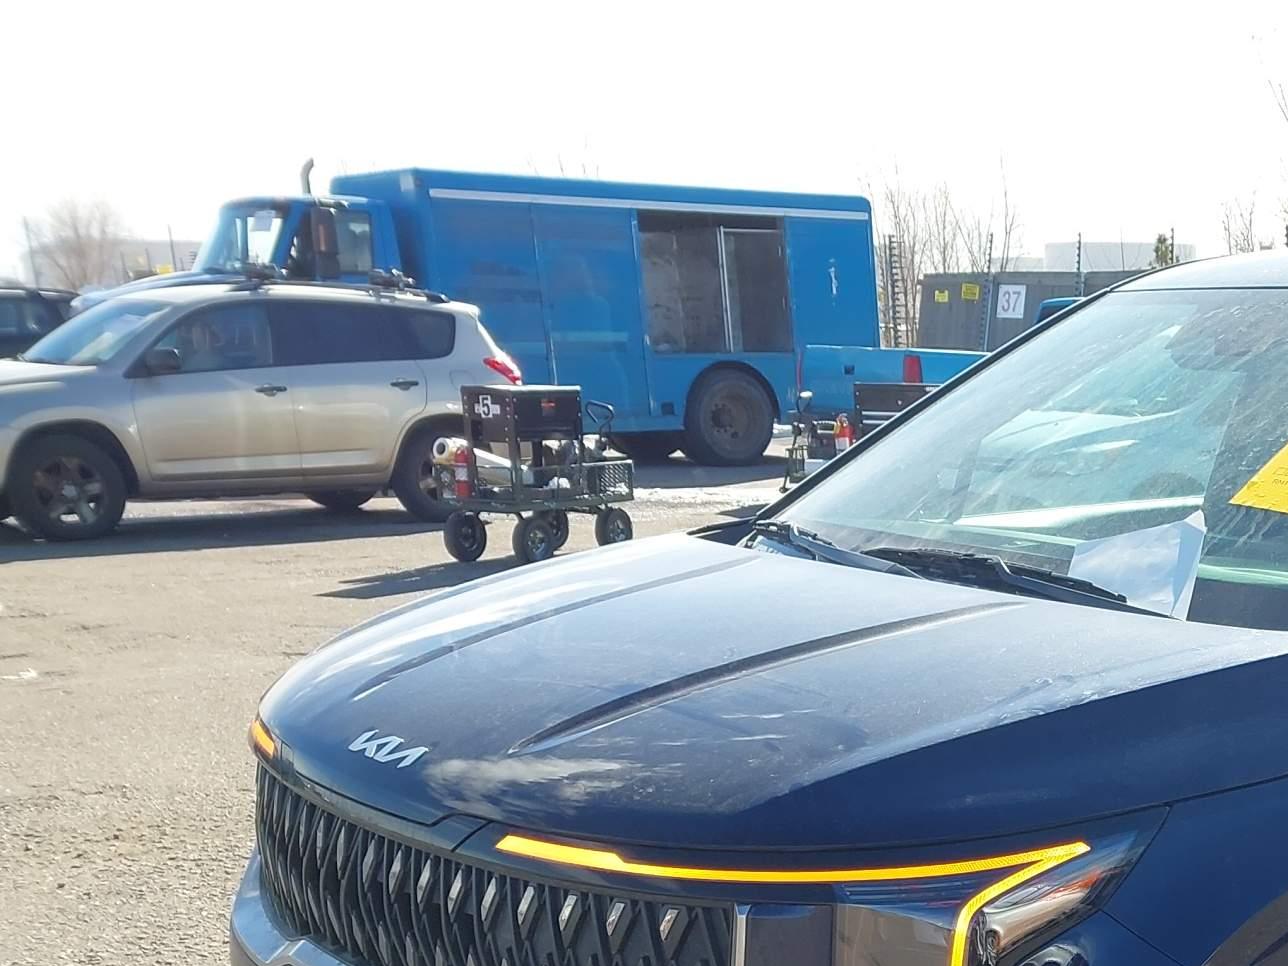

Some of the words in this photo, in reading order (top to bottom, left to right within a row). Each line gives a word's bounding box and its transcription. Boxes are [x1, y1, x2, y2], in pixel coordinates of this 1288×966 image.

[1001, 290, 1022, 313] 37
[481, 396, 491, 417] 5
[348, 729, 429, 768] KIA
